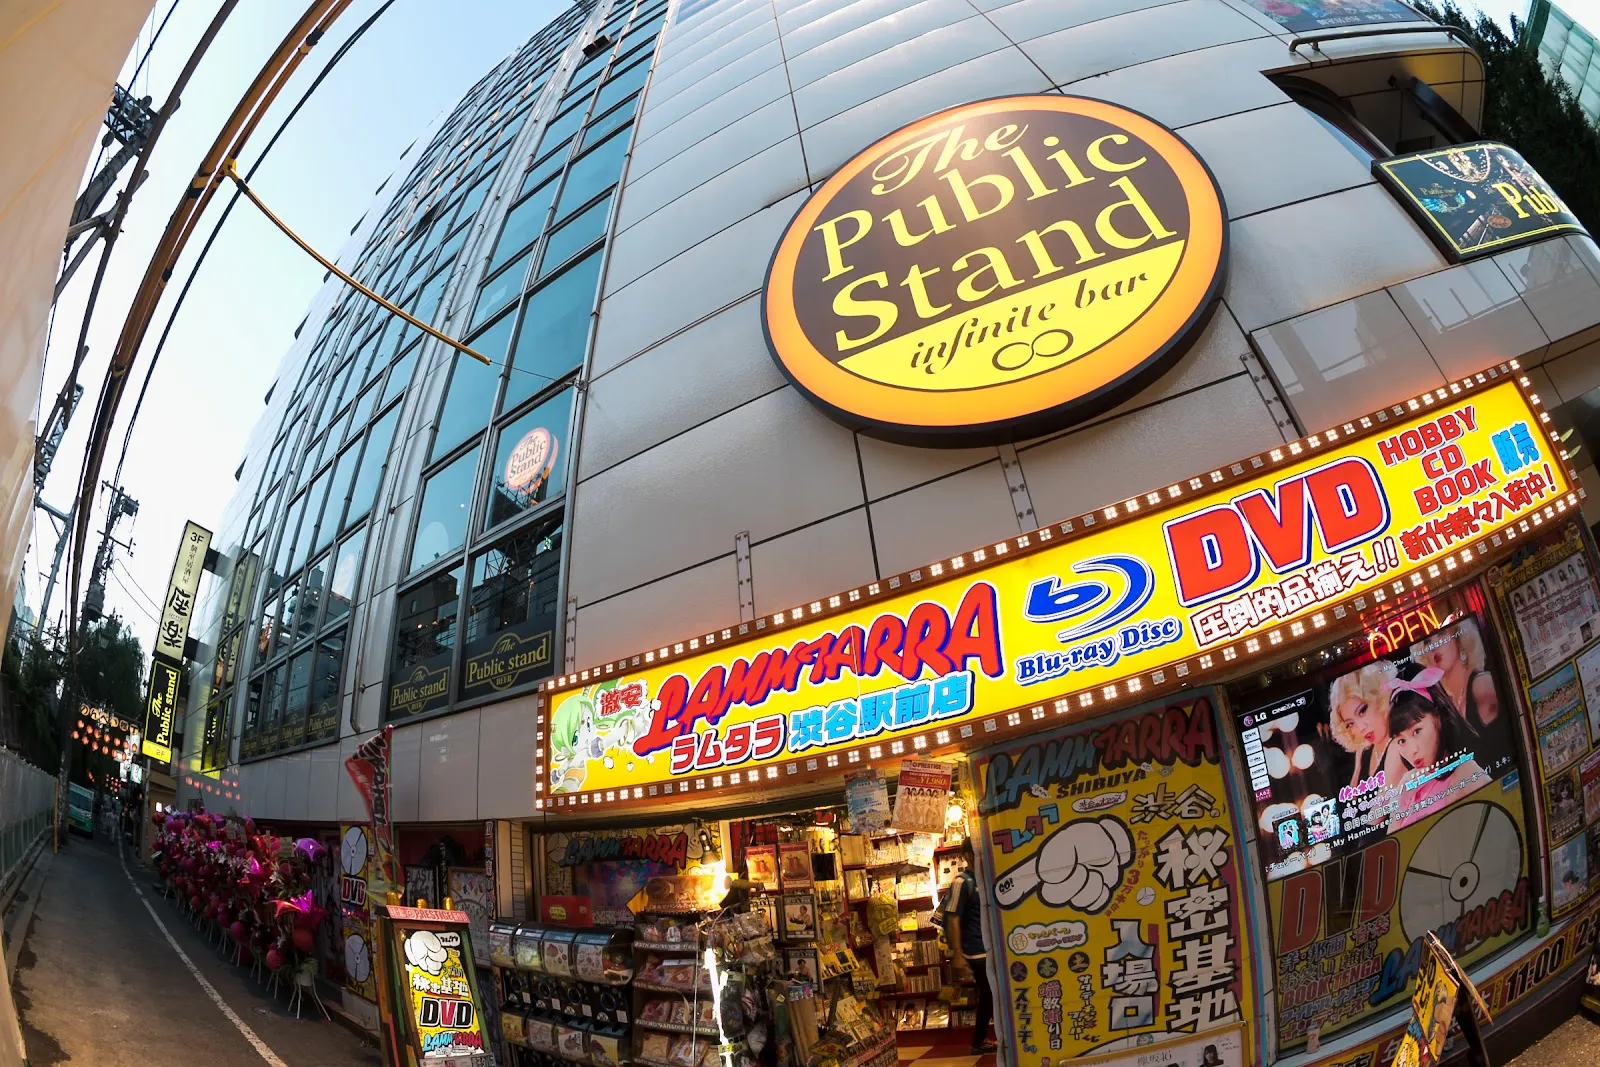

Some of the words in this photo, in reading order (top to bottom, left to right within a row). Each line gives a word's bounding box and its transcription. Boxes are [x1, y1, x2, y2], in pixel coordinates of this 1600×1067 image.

[871, 122, 1029, 196] The
[813, 132, 1148, 283] Public
[832, 175, 1179, 353] Stand
[909, 302, 1057, 376] infinite
[1074, 272, 1148, 309] bar
[511, 440, 546, 467] Public
[1377, 405, 1478, 466] HOBBY
[1491, 422, 1541, 476] 販売
[509, 451, 542, 478] Stand
[1413, 459, 1498, 515] BOOK
[1422, 444, 1467, 482] CD
[190, 532, 204, 544] 3F
[1167, 459, 1387, 603] DVD
[468, 660, 505, 682] Public
[507, 638, 547, 671] stand
[496, 638, 516, 654] The
[1018, 640, 1113, 681] Blu-ray
[1121, 618, 1175, 646] Disc
[151, 692, 163, 718] The
[156, 709, 172, 746] Public
[165, 671, 178, 707] stand
[392, 686, 418, 706] Public
[419, 672, 447, 697] stand
[600, 683, 642, 717] 激安
[790, 674, 968, 747] 渋谷駅前店
[1255, 712, 1268, 722] LG
[1271, 702, 1296, 715] CINEMA
[672, 717, 781, 771] ラムタラ
[1056, 770, 1148, 799] SHIBUYA
[1347, 818, 1394, 842] Hamburger
[342, 878, 367, 906] DVD
[1278, 837, 1400, 956] DVD
[1153, 824, 1243, 1034] 秘密基地
[1101, 919, 1159, 1032] 入場口
[1282, 975, 1331, 1011] BOOK
[1332, 953, 1384, 993] TENGA
[1506, 936, 1566, 1004] 11:00
[421, 997, 475, 1029] DVD
